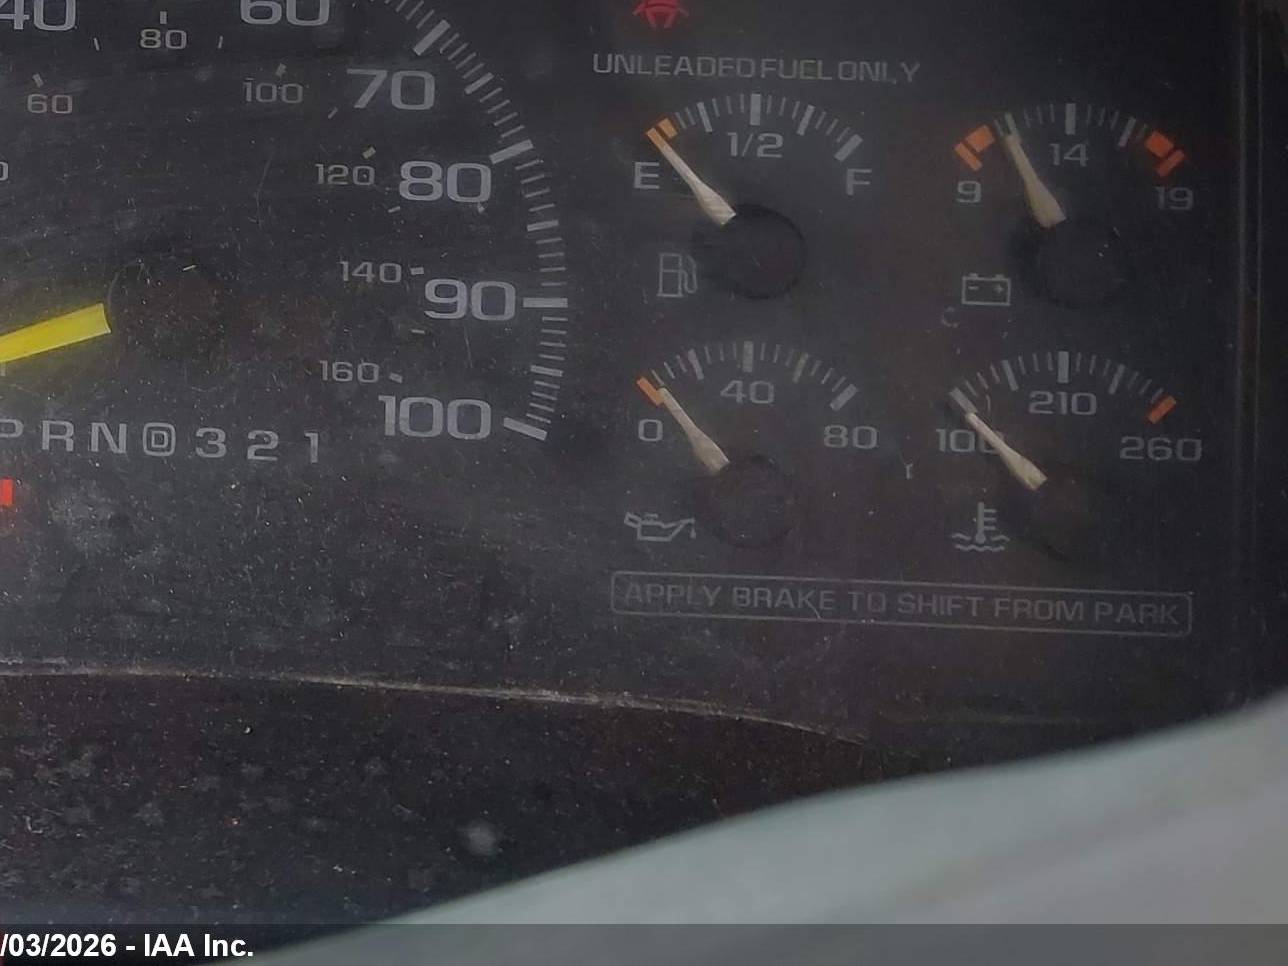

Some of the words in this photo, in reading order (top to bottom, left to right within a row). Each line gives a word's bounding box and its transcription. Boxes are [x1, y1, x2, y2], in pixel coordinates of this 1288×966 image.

[140, 29, 187, 49] 80
[592, 53, 756, 78] UNLEADED
[760, 58, 832, 81] FUEL
[838, 60, 920, 83] ONLY
[243, 81, 303, 104] 100
[346, 68, 435, 110] 70
[27, 94, 72, 114] 60
[728, 133, 784, 159] 1/2
[1051, 142, 1089, 167] 14
[315, 164, 375, 186] 120
[399, 161, 491, 202] 80
[634, 161, 659, 189] E
[846, 169, 873, 196] F
[956, 180, 982, 204] 9
[1155, 186, 1193, 211] 19
[339, 261, 401, 283] 140
[424, 279, 516, 321] 90
[319, 360, 379, 383] 160
[721, 380, 775, 405] 40
[1029, 390, 1097, 416] 210
[378, 395, 492, 440] 100
[638, 419, 663, 442] 0
[823, 425, 879, 450] 80
[1120, 436, 1203, 462] 260
[624, 583, 722, 607] APPLY
[732, 586, 836, 610] BRAKE
[847, 591, 886, 613] TO
[896, 592, 984, 617] SHIFT
[994, 598, 1084, 621] FROM
[1095, 601, 1178, 624] PARK
